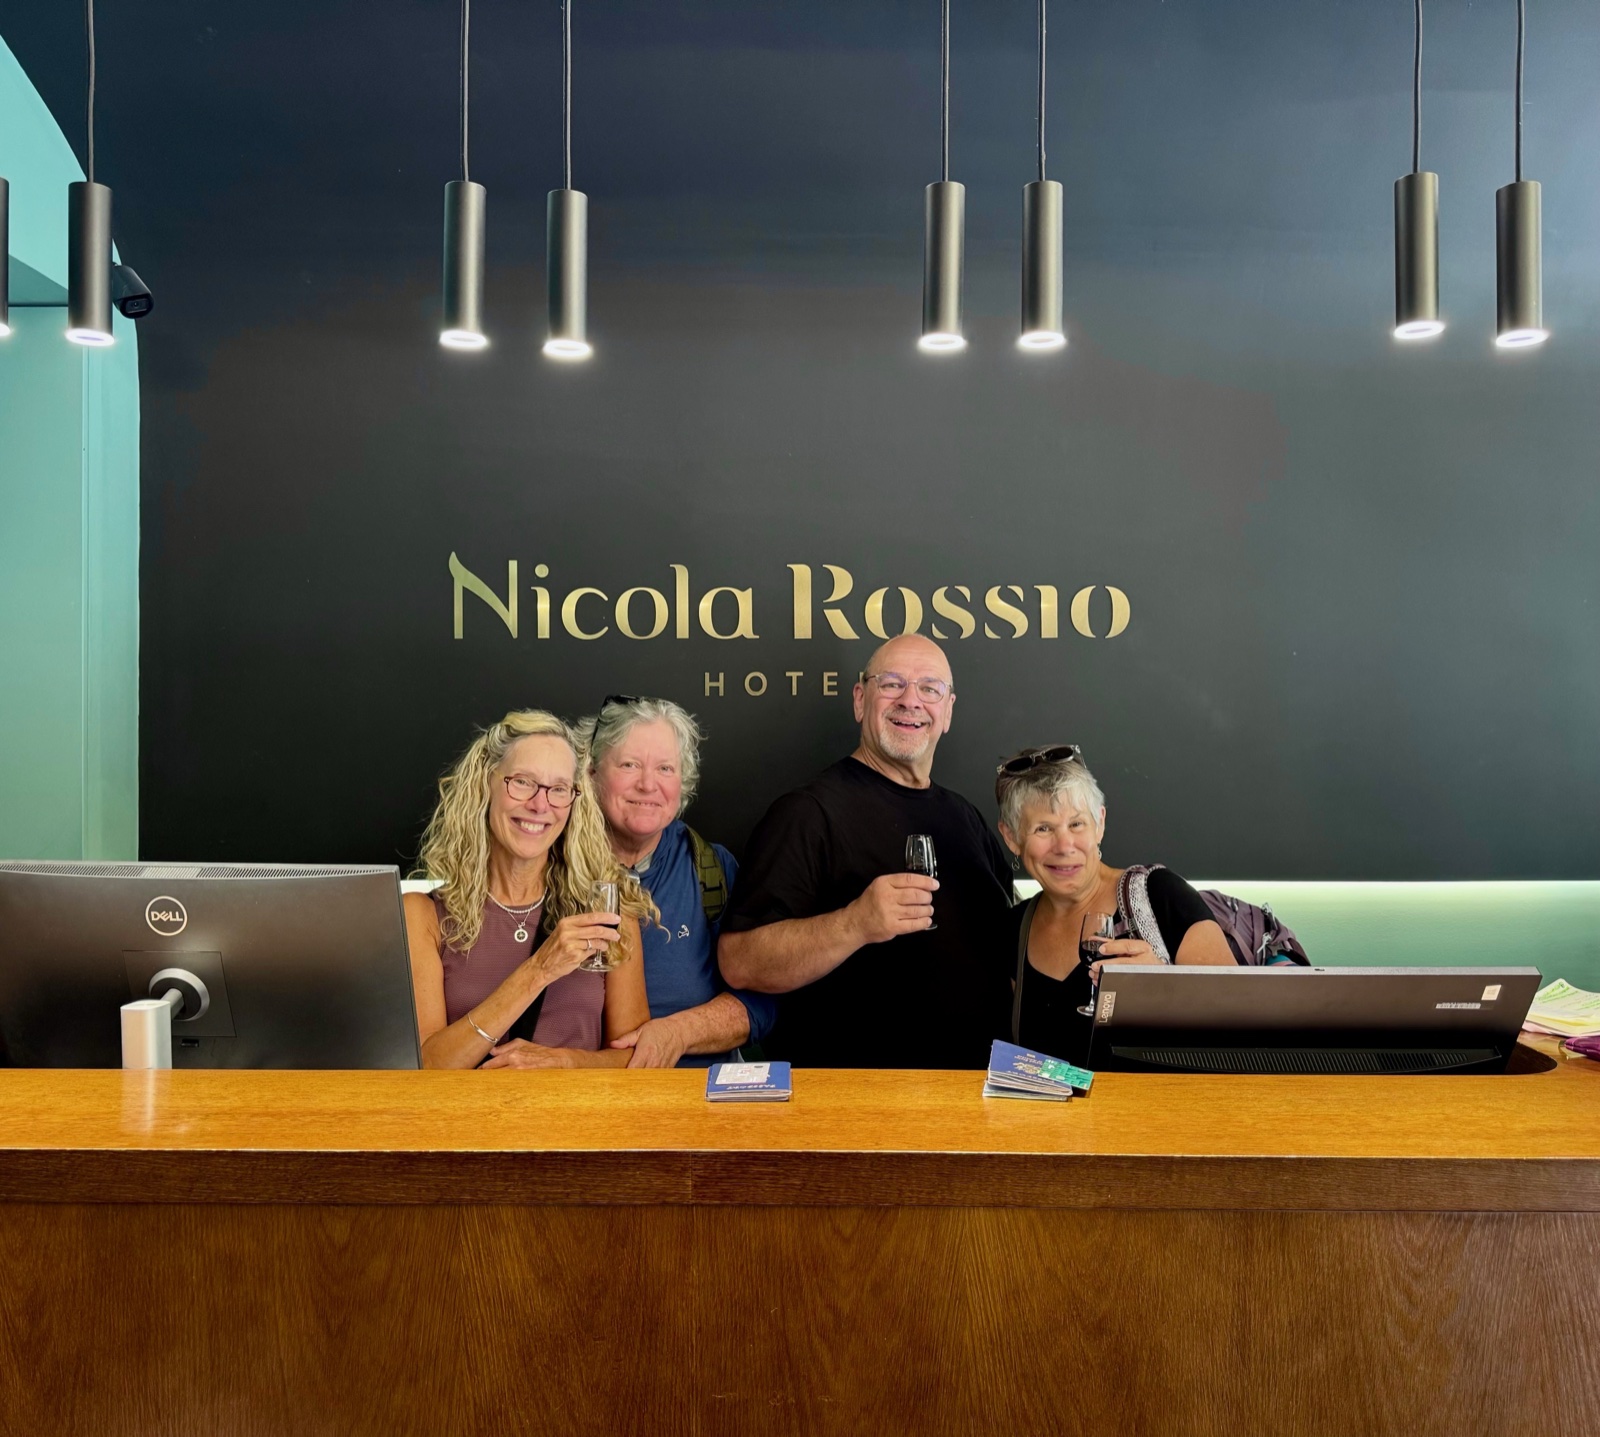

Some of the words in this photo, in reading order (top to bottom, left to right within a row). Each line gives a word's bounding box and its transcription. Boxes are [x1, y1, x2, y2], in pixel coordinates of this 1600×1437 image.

[449, 551, 760, 640] Nicola
[704, 671, 864, 696] HOTE
[150, 911, 184, 922] DELL
[1098, 993, 1112, 1023] Lenovo
